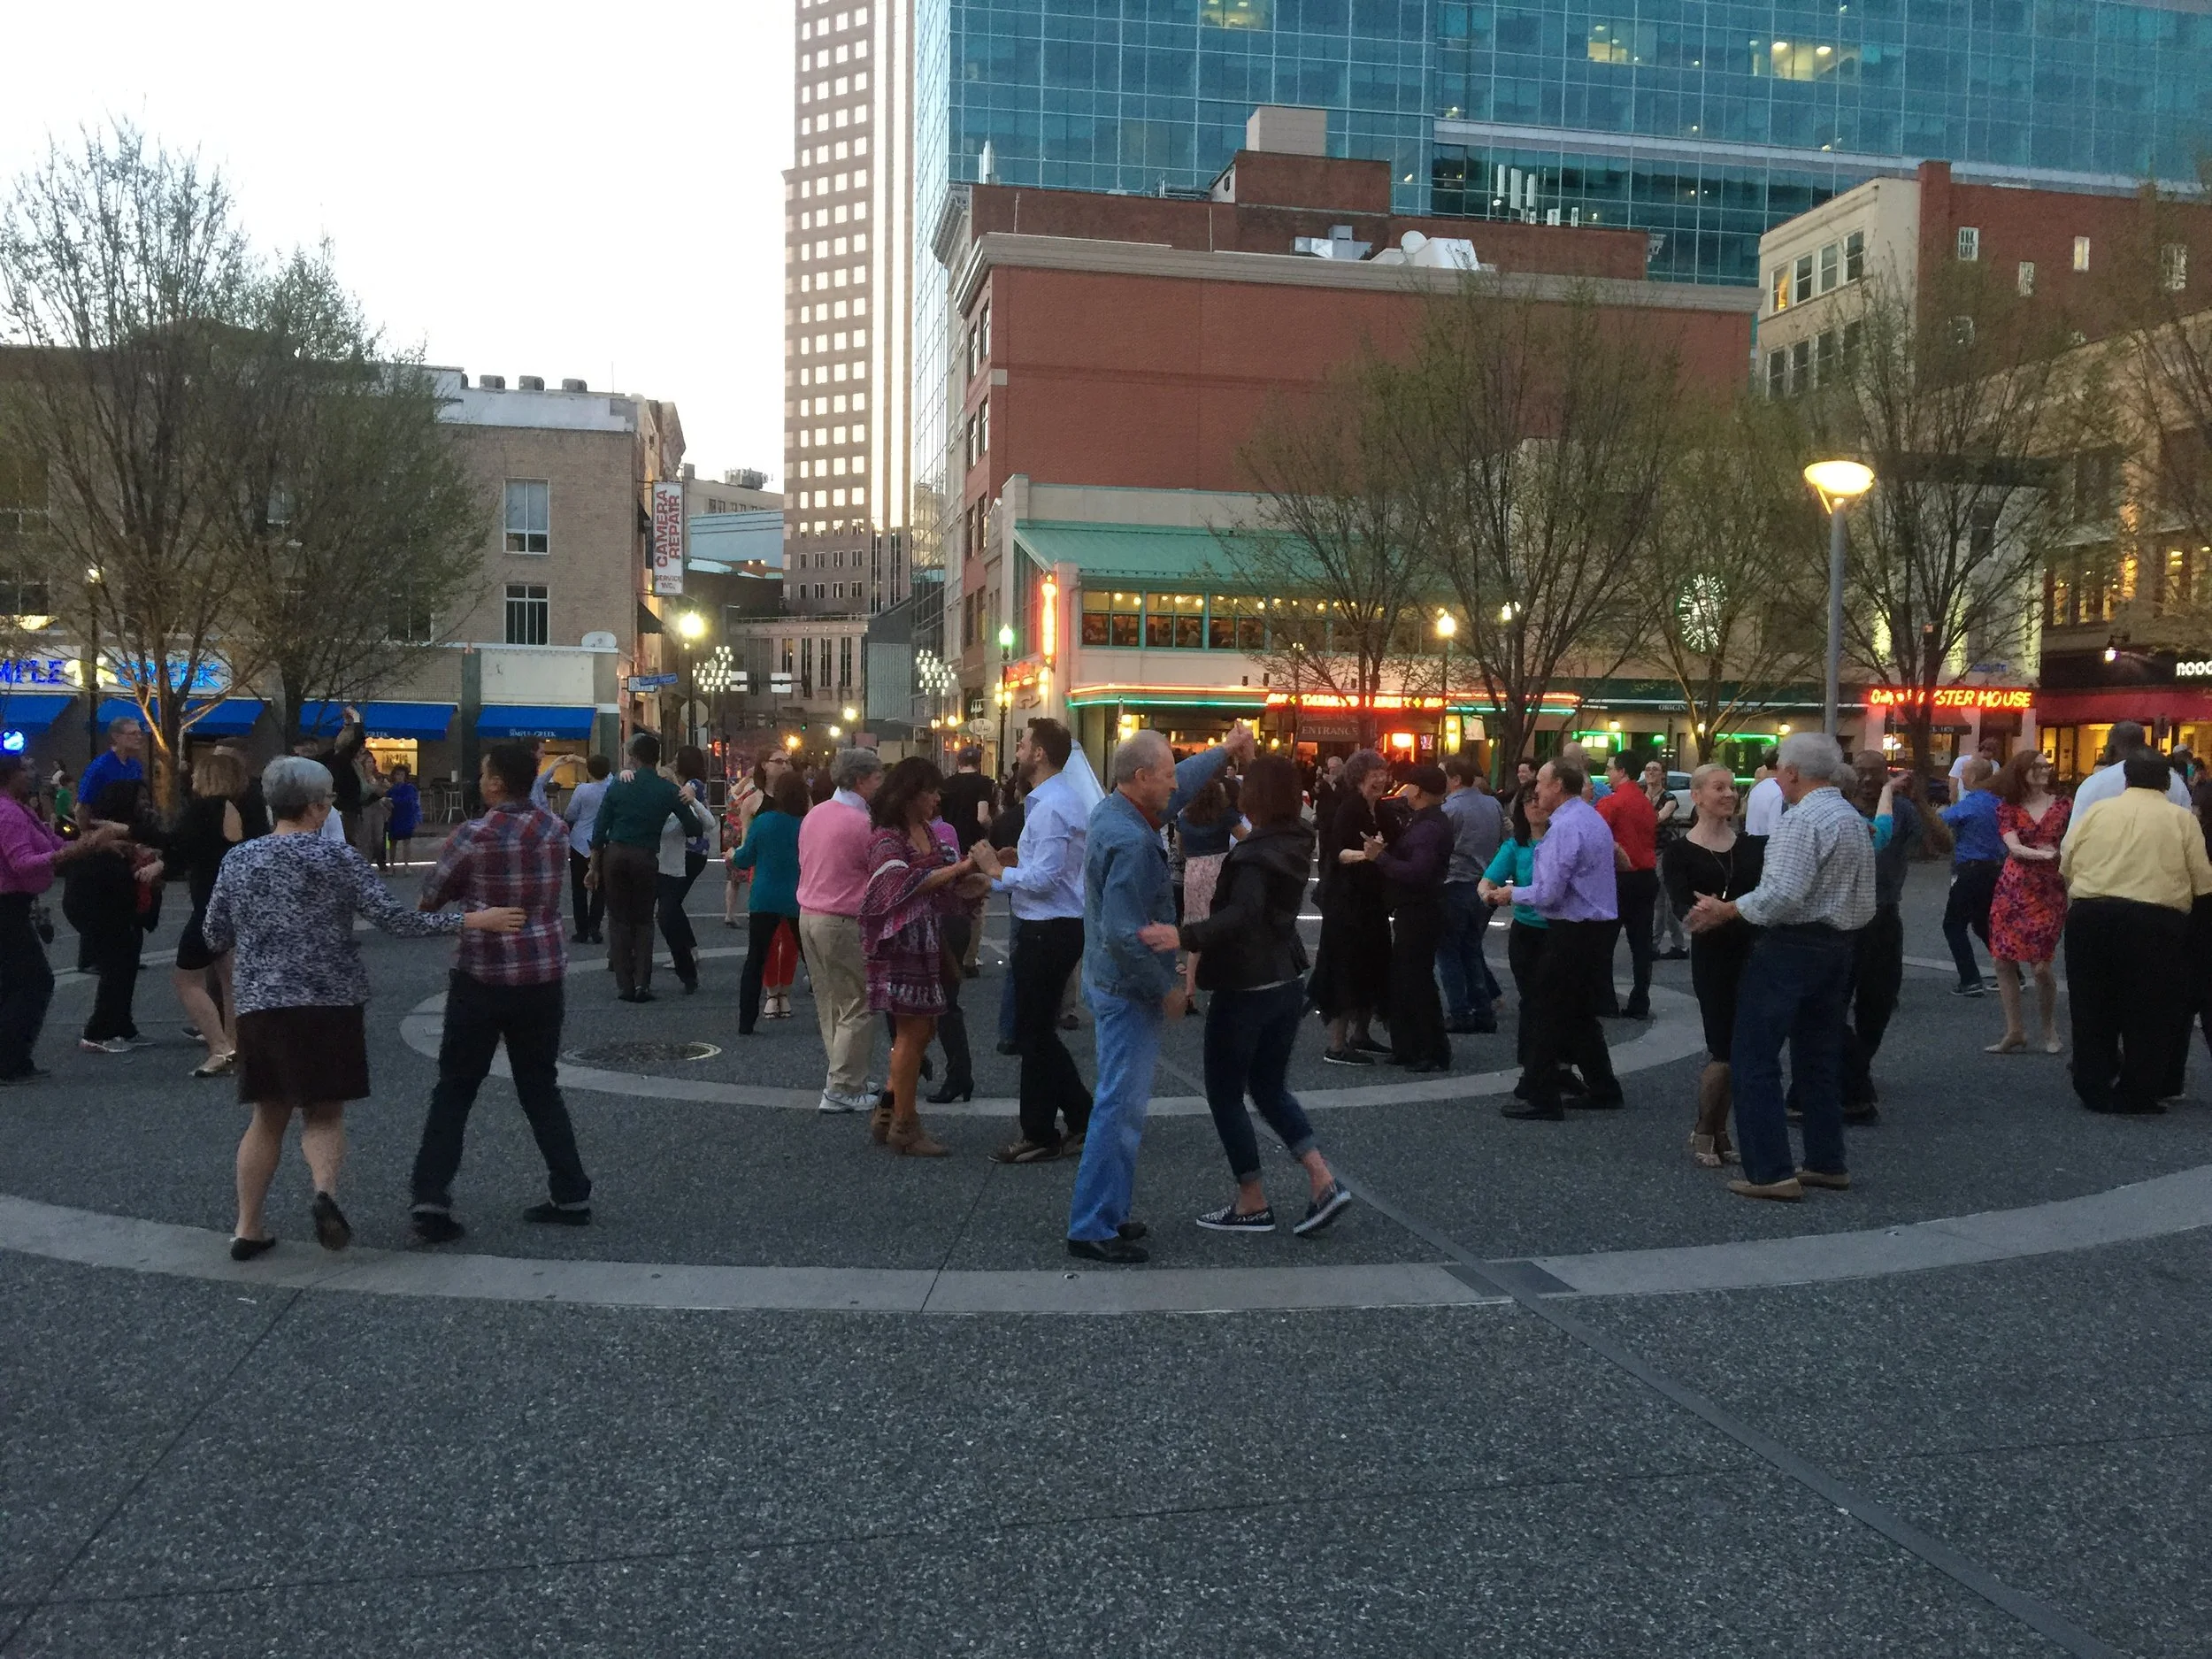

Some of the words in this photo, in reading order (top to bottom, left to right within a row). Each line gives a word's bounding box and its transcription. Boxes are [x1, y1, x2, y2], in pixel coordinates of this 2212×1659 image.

[656, 489, 668, 567] CAMERA
[669, 495, 680, 559] REPAIR
[1977, 690, 2032, 707] HOUSE
[1302, 725, 1359, 736] ENTRANCE
